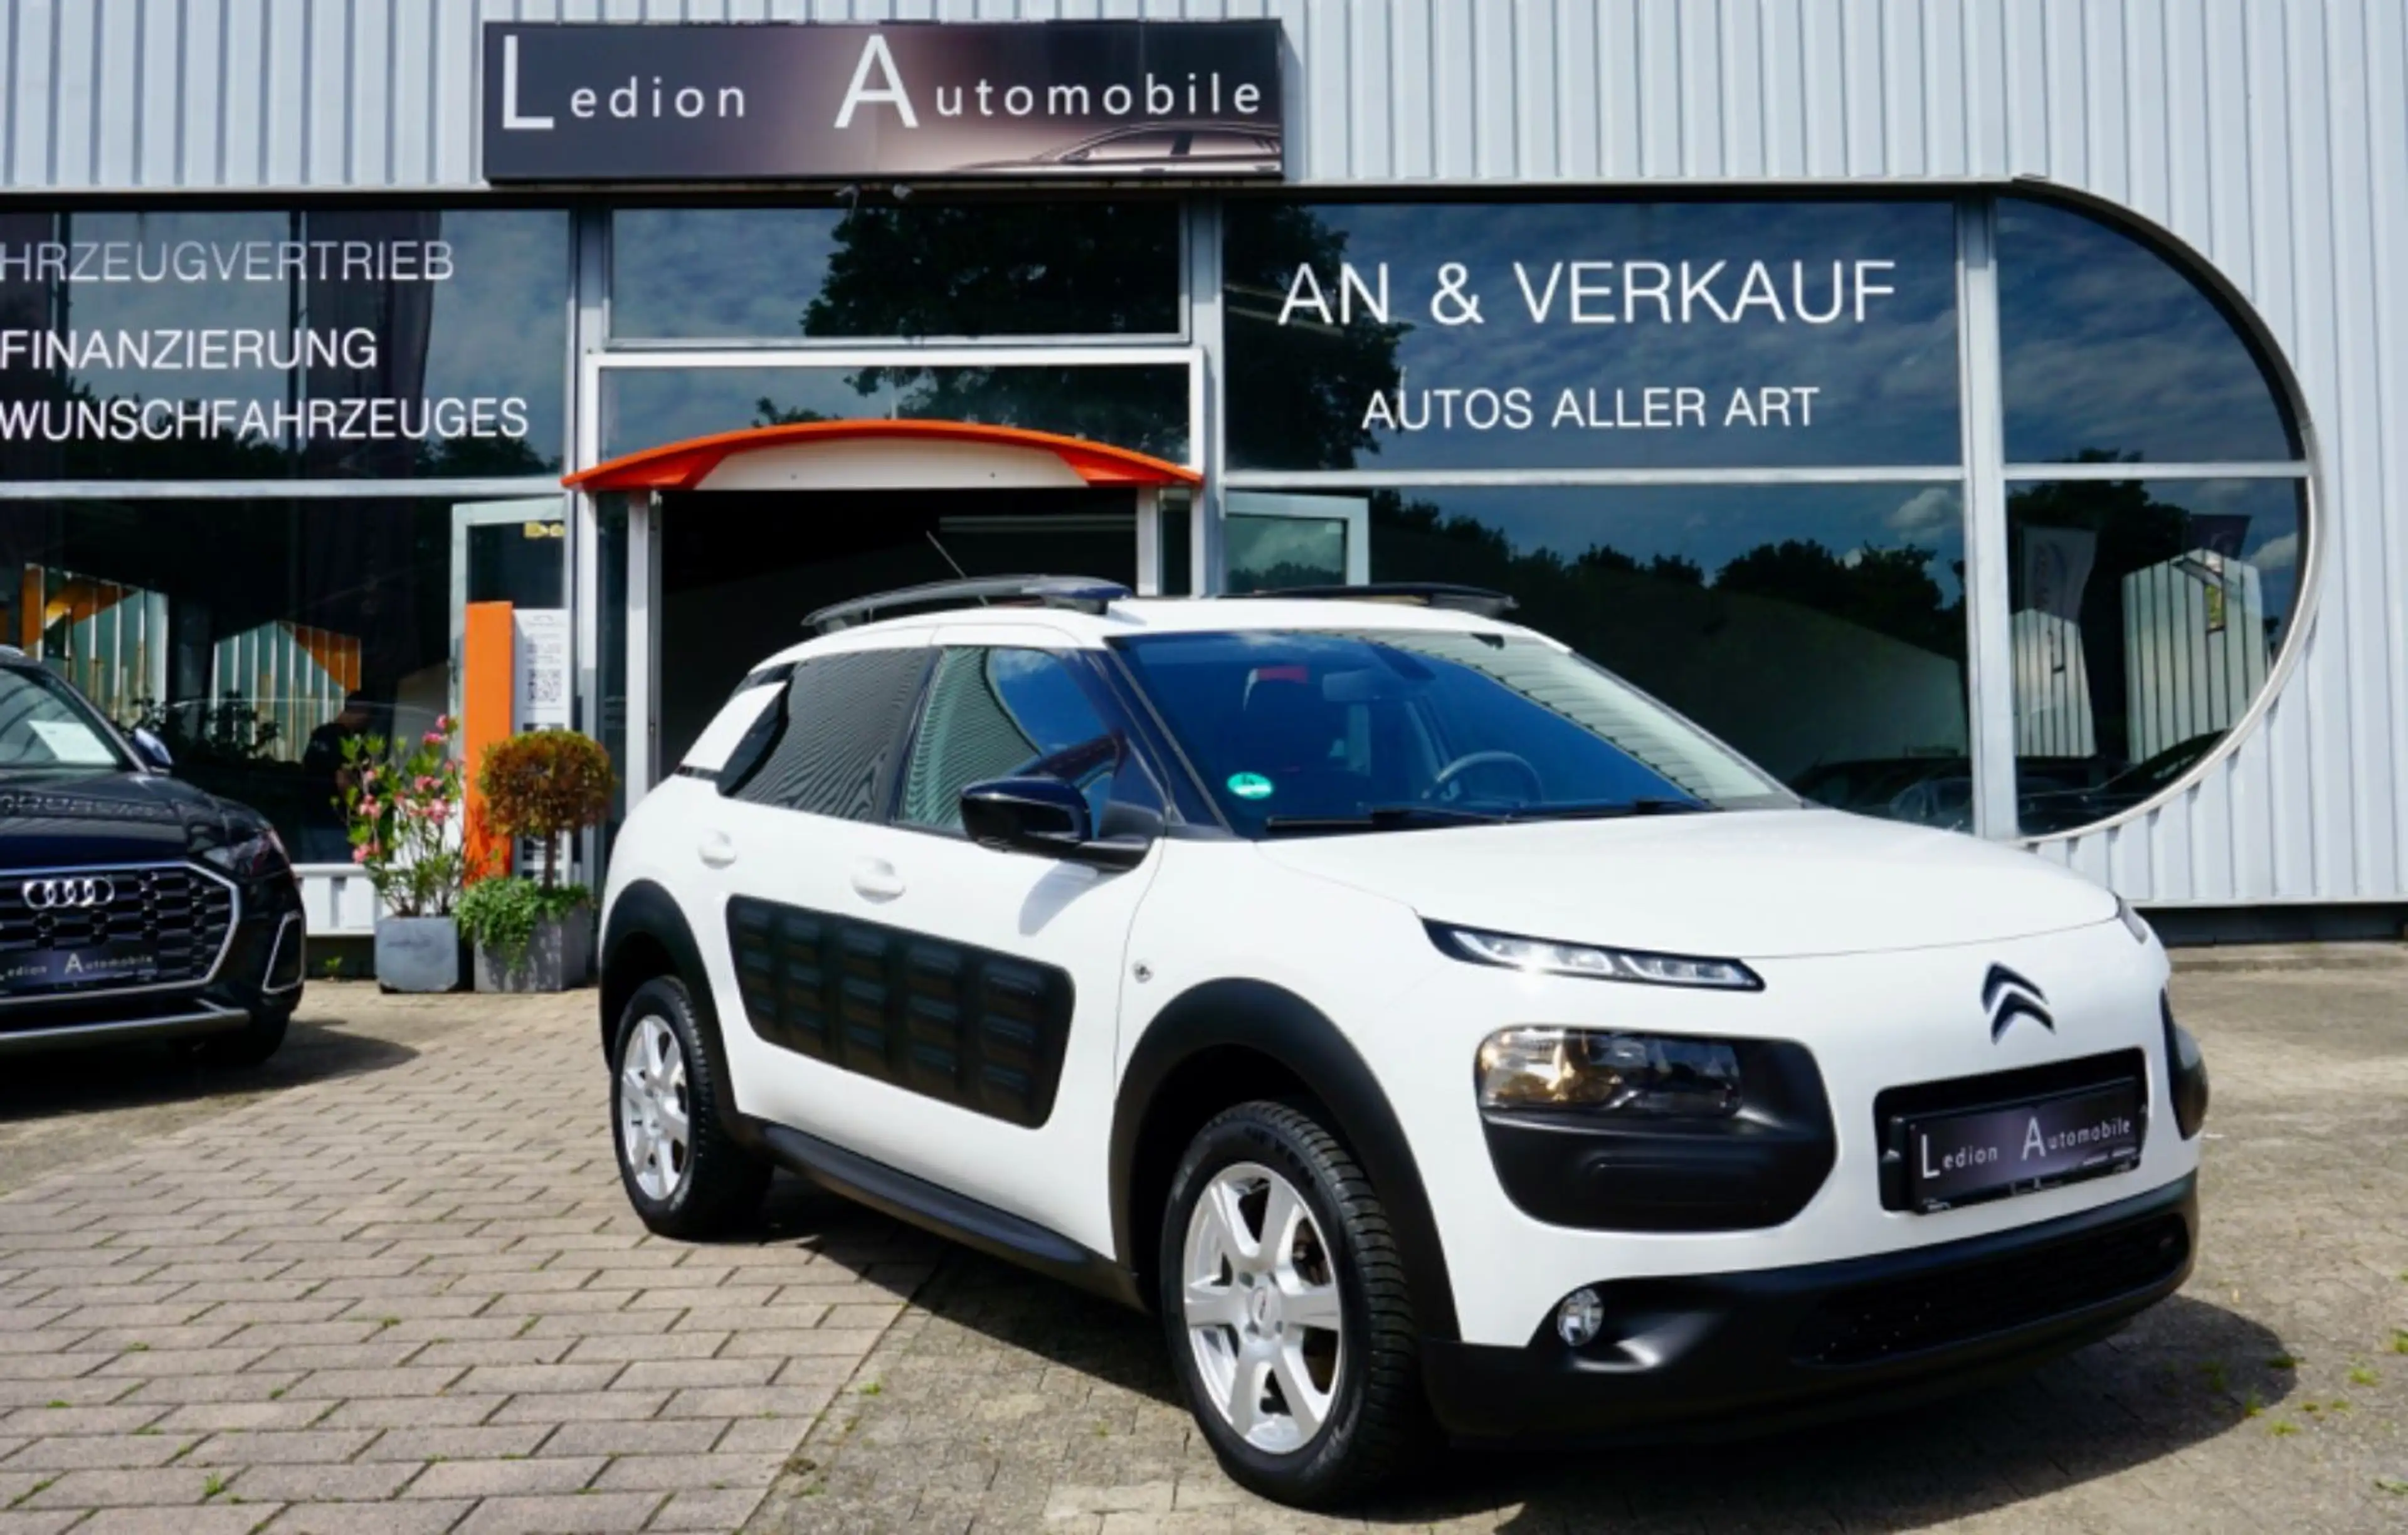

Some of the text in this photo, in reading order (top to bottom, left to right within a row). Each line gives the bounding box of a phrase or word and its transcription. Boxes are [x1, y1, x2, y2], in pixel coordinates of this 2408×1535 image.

[503, 34, 1262, 130] Ledion Automobile
[0, 240, 455, 284] HRZEUGVERTRIEB
[1277, 260, 1896, 327] AN & VERKAUF
[0, 327, 378, 371] FINANZIERUNG
[0, 396, 531, 441] WUNSCHFAHRZEUGES
[1361, 386, 1821, 431] AUTOS ALLER ART
[1920, 1116, 2131, 1179] Ledion Automobile
